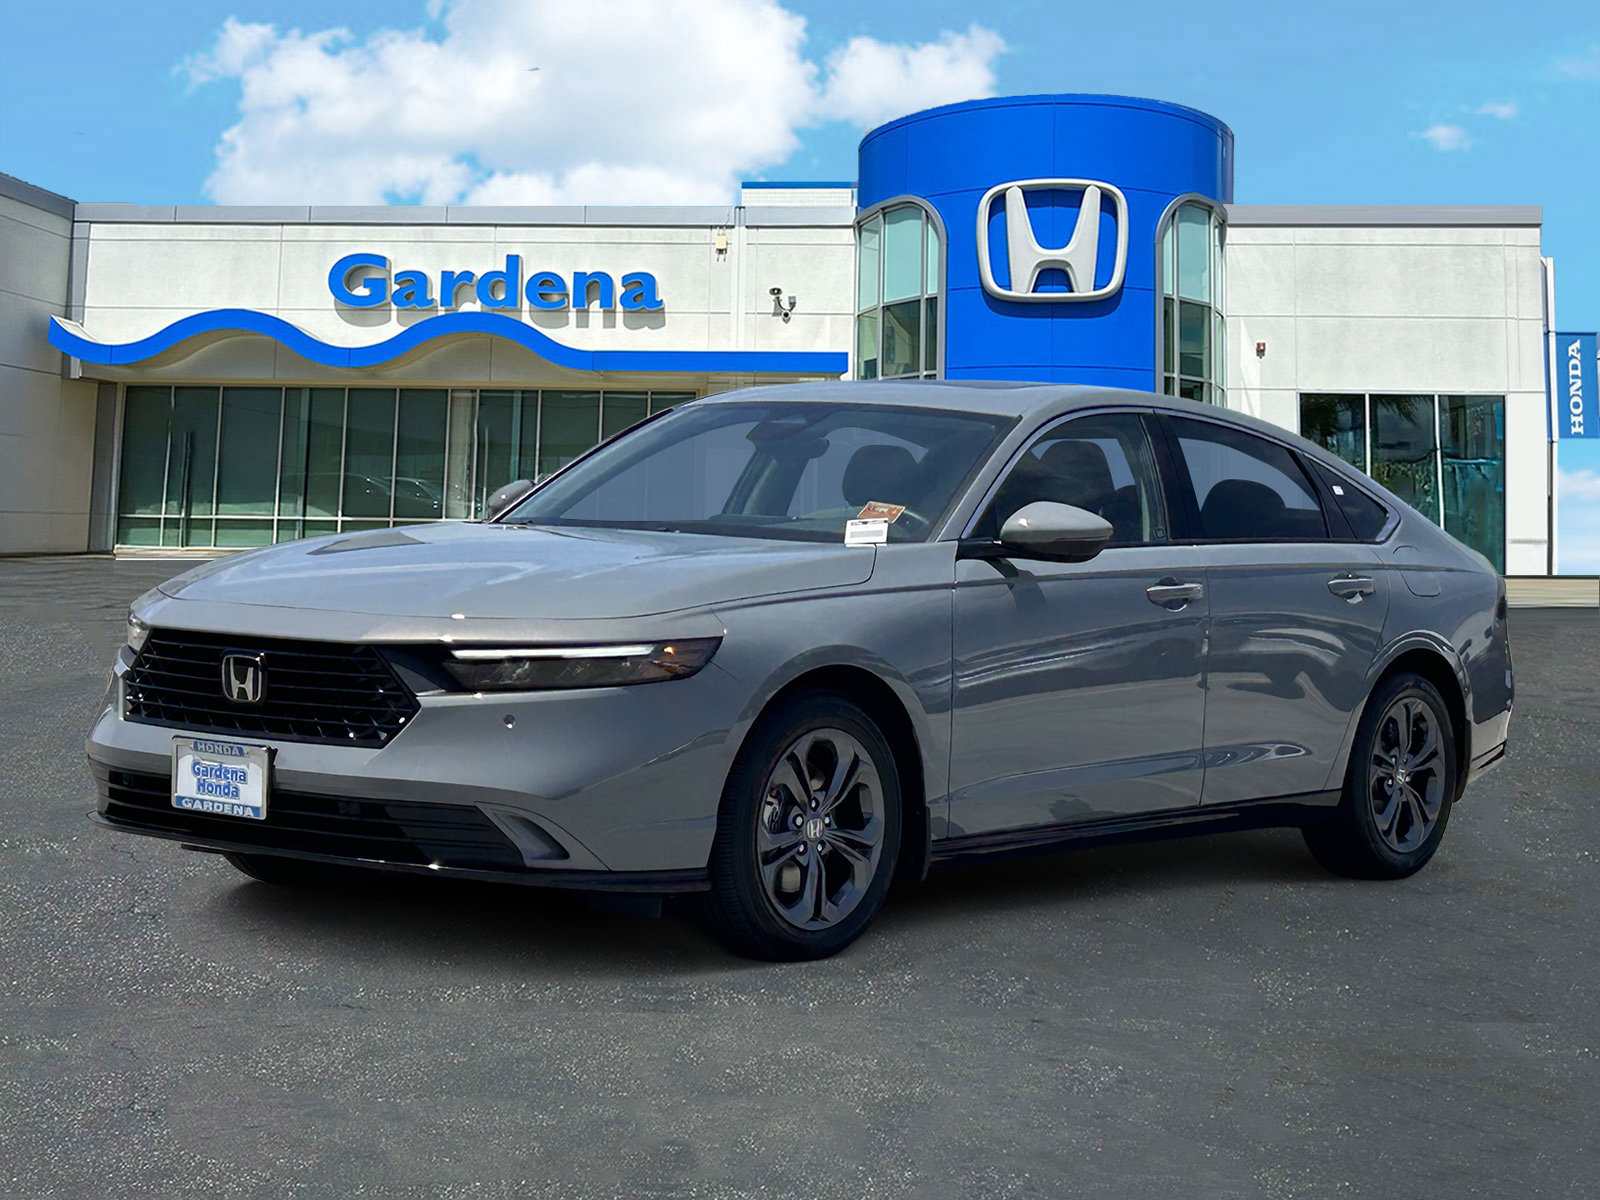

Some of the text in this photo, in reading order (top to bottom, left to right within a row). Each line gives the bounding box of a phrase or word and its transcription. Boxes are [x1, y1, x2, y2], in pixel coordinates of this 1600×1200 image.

[328, 253, 664, 310] Gardena
[1568, 339, 1584, 435] HONDA
[197, 741, 241, 756] HONDA
[191, 760, 248, 784] Gardena
[196, 779, 240, 800] Honda
[181, 798, 255, 817] GARDENA
